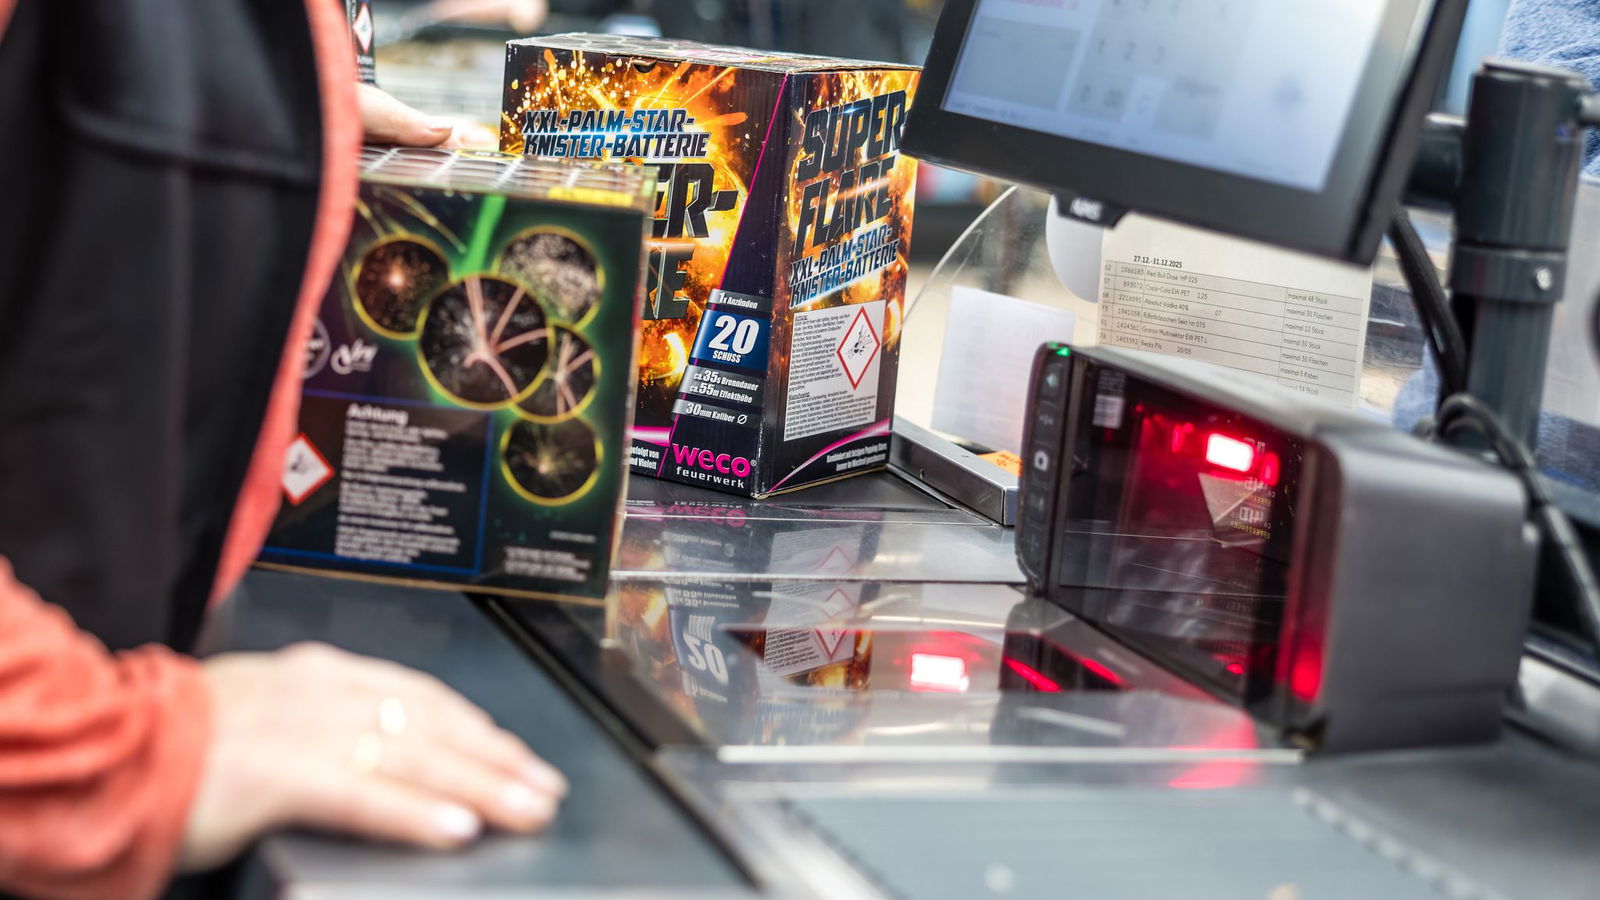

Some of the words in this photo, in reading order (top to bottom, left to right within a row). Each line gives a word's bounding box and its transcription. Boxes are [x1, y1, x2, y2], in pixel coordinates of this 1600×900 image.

[523, 109, 695, 134] XXL-PALM-STAR-
[522, 131, 711, 158] KNISTER-BATTERIE
[794, 155, 895, 254] FLARE
[791, 223, 893, 287] XXL-PALM-STAR-
[789, 239, 899, 309] KNISTER-BATTERIE
[727, 297, 758, 310] Anzünden
[1288, 292, 1308, 302] maximal
[1286, 306, 1306, 317] maximal
[1312, 310, 1334, 321] Flaschen
[1284, 322, 1304, 332] maximal
[708, 315, 760, 355] 20
[1283, 336, 1302, 347] maximal
[712, 350, 742, 364] SCHUSS
[1282, 351, 1301, 362] maximal
[1308, 354, 1328, 366] Flaschen
[1280, 366, 1299, 376] maximal
[721, 376, 759, 392] Brenndauer
[719, 389, 753, 404] Effekthöhe
[712, 409, 736, 423] Kaliber
[672, 444, 751, 477] weco
[676, 466, 745, 488] feuerwerk
